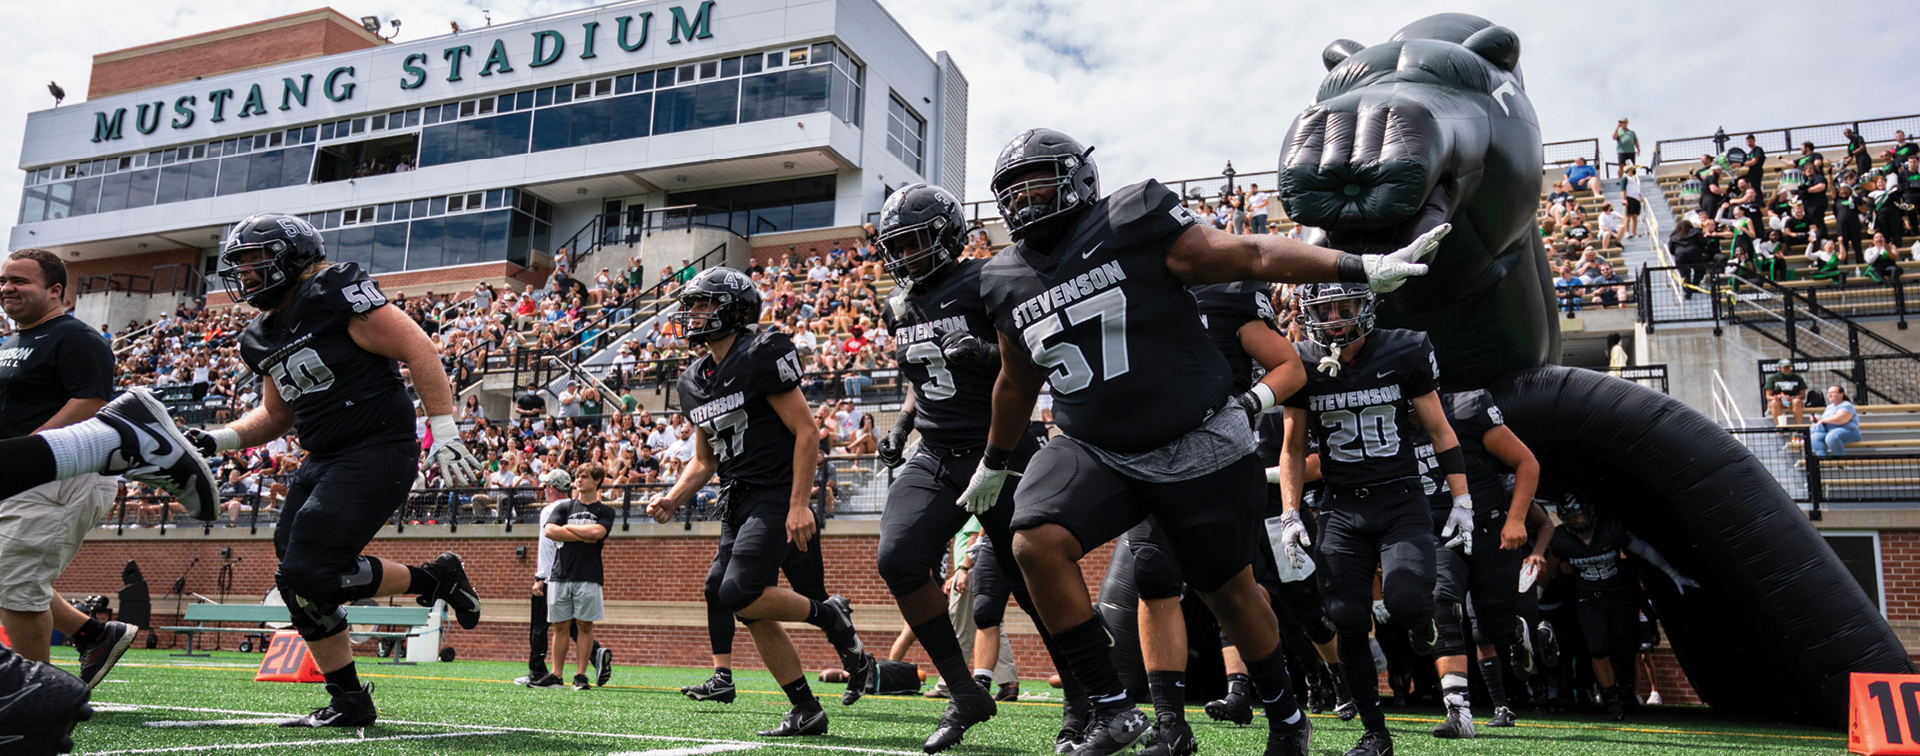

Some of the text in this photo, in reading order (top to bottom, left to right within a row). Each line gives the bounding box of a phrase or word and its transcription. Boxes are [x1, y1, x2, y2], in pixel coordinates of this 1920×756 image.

[91, 0, 715, 143] MUSTANG STADIUM
[277, 218, 313, 238] 50
[341, 280, 386, 313] 50
[1012, 260, 1127, 329] STEVENSON
[1023, 286, 1130, 395] 57
[268, 347, 335, 402] 50
[775, 350, 804, 383] 47
[906, 341, 957, 401] 3
[1621, 370, 1650, 378] SECTION
[690, 391, 745, 424] STEVENSON
[1309, 384, 1402, 411] STEVENSON
[1320, 404, 1401, 463] 20
[260, 637, 307, 674] 20
[1868, 681, 1920, 745] 10
